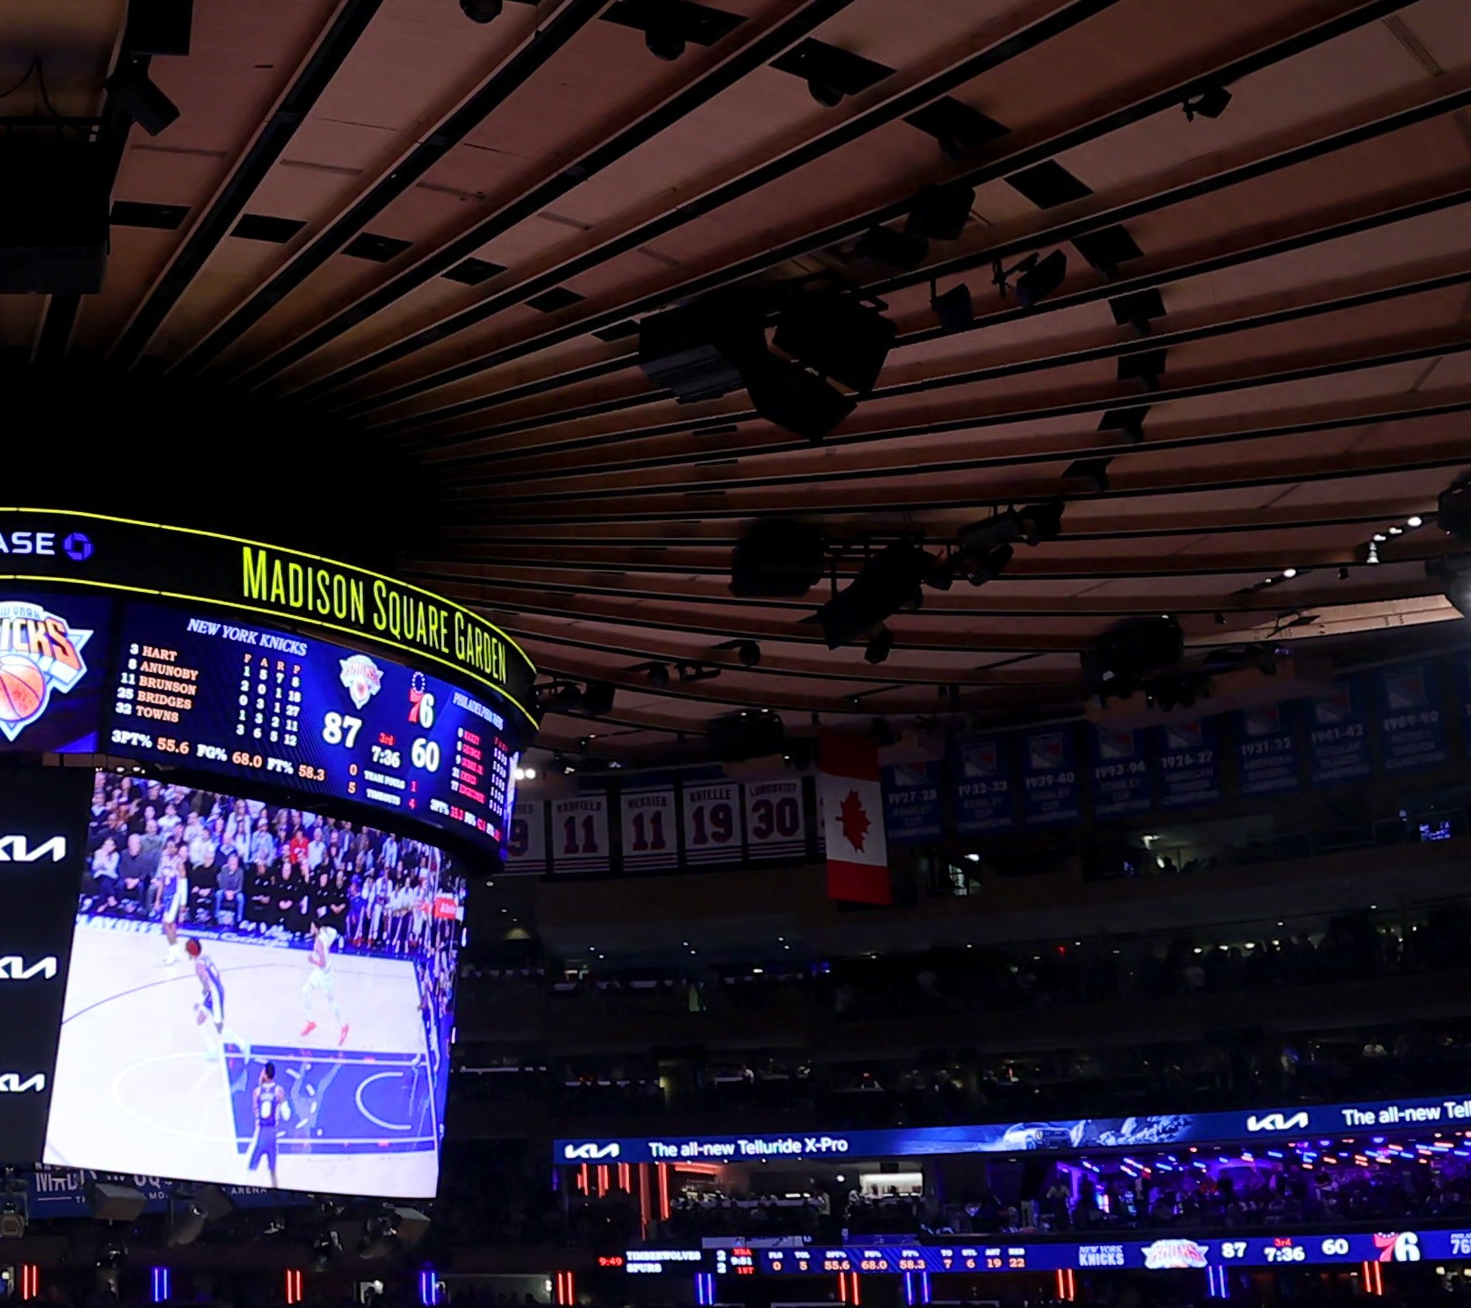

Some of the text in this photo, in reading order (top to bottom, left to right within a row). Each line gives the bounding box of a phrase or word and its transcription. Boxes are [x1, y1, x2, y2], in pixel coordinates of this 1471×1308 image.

[243, 547, 506, 684] MADISON SQUARE GARDEN
[187, 619, 308, 656] NEW YORK KNICKS
[143, 646, 177, 661] HART
[140, 661, 301, 702] ANUNOBY 18
[139, 676, 300, 717] BRUNSON 27
[137, 691, 298, 731] BRIDGES 11
[136, 706, 297, 746] TOWNS 12
[323, 712, 362, 748] 87
[379, 733, 394, 745] 3rd
[111, 730, 325, 780] 3PT% 55.6 FG% 68.0 FT% 58.3
[371, 746, 400, 768] 7:36
[412, 738, 439, 772] 60
[364, 770, 405, 789] TEAM FOULS
[366, 788, 400, 805] TIMEOUTS
[691, 803, 733, 844] 19
[752, 797, 800, 840] 30
[563, 815, 599, 854] 11
[632, 811, 666, 851] 11
[1247, 1112, 1309, 1131] KIA
[1343, 1109, 1364, 1126] The
[1378, 1107, 1440, 1124] all-new
[564, 1143, 619, 1158] KIA
[649, 1137, 848, 1157] The all-new Telluride X-Pro
[1100, 1245, 1123, 1254] YORK
[1221, 1242, 1246, 1258] 87
[1273, 1237, 1291, 1247] 3rd
[1321, 1239, 1349, 1255] 60
[599, 1256, 622, 1267] 9:49
[626, 1250, 726, 1261] TIMBERWOLVES 2
[824, 1258, 1025, 1271] 55.6 68.0 58.3 19 22
[1079, 1252, 1124, 1266] KNICKS
[1264, 1247, 1305, 1263] 7:36
[627, 1263, 726, 1274] SPURS 2
